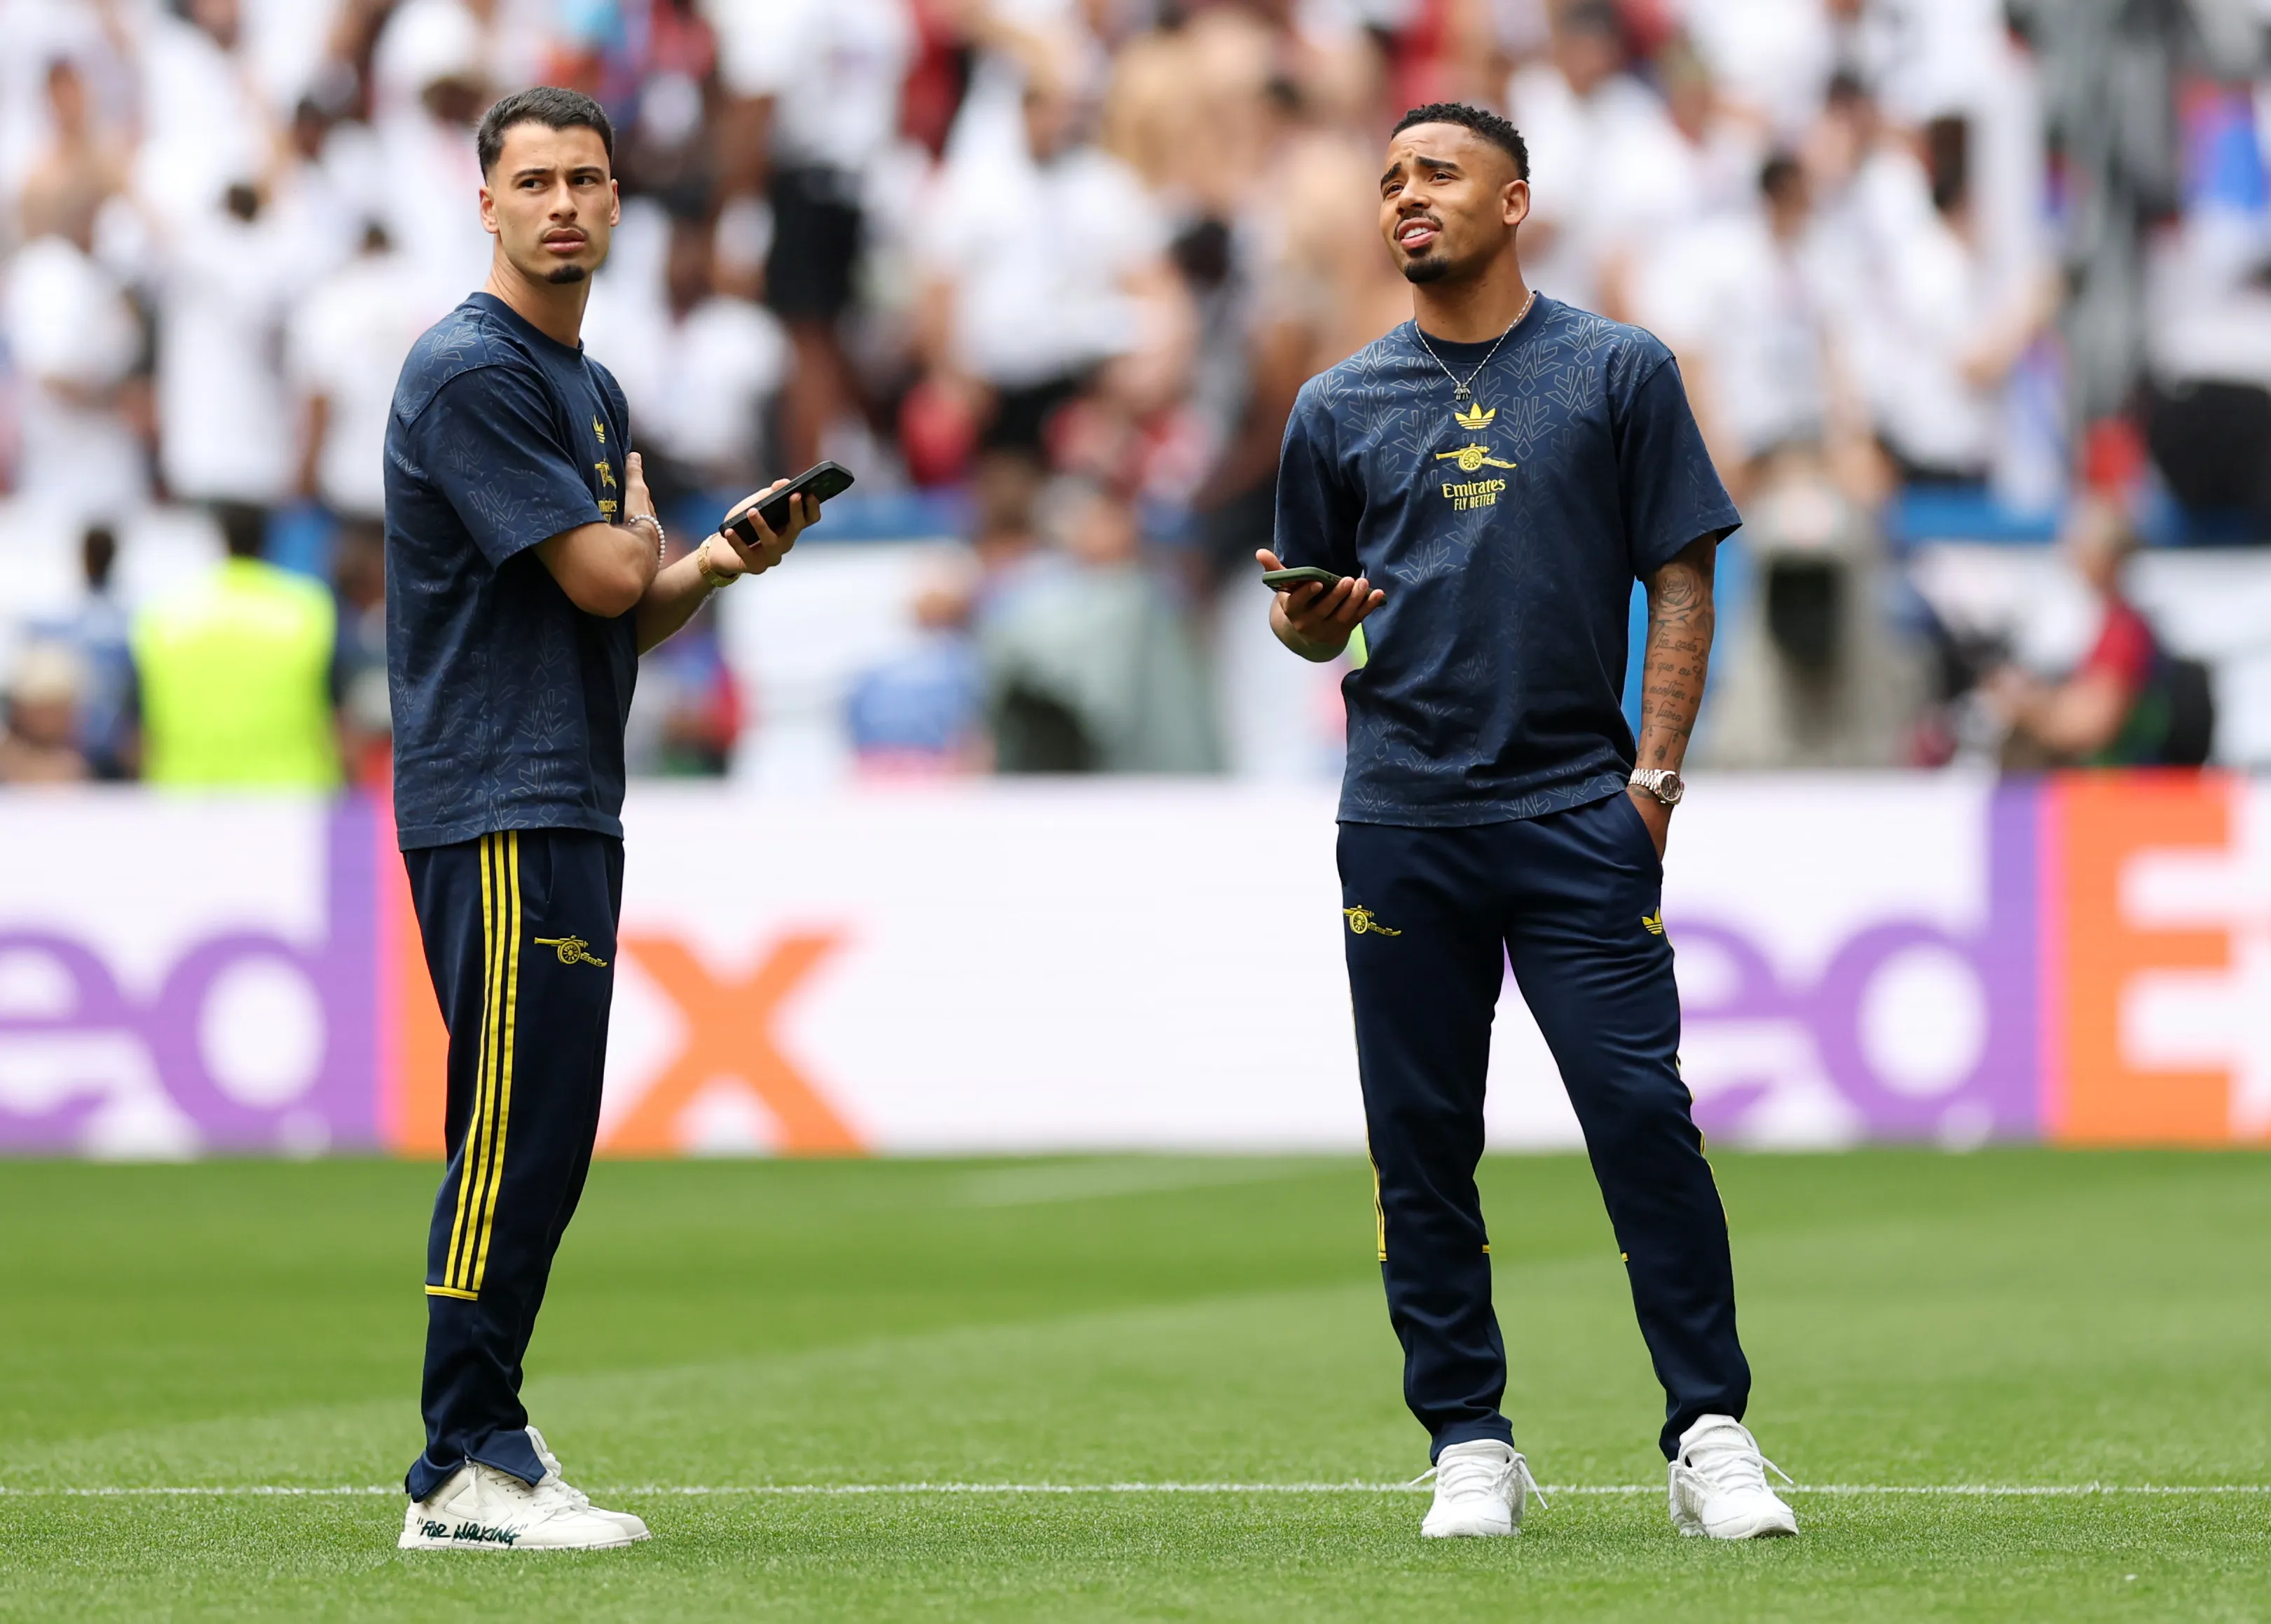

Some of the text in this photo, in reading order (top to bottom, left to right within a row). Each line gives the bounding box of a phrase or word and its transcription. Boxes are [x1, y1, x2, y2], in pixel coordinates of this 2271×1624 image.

[1441, 479, 1506, 499] Emirates
[1454, 493, 1496, 511] FLY BETTER
[0, 771, 876, 1156] edx
[1503, 767, 2271, 1152] edE
